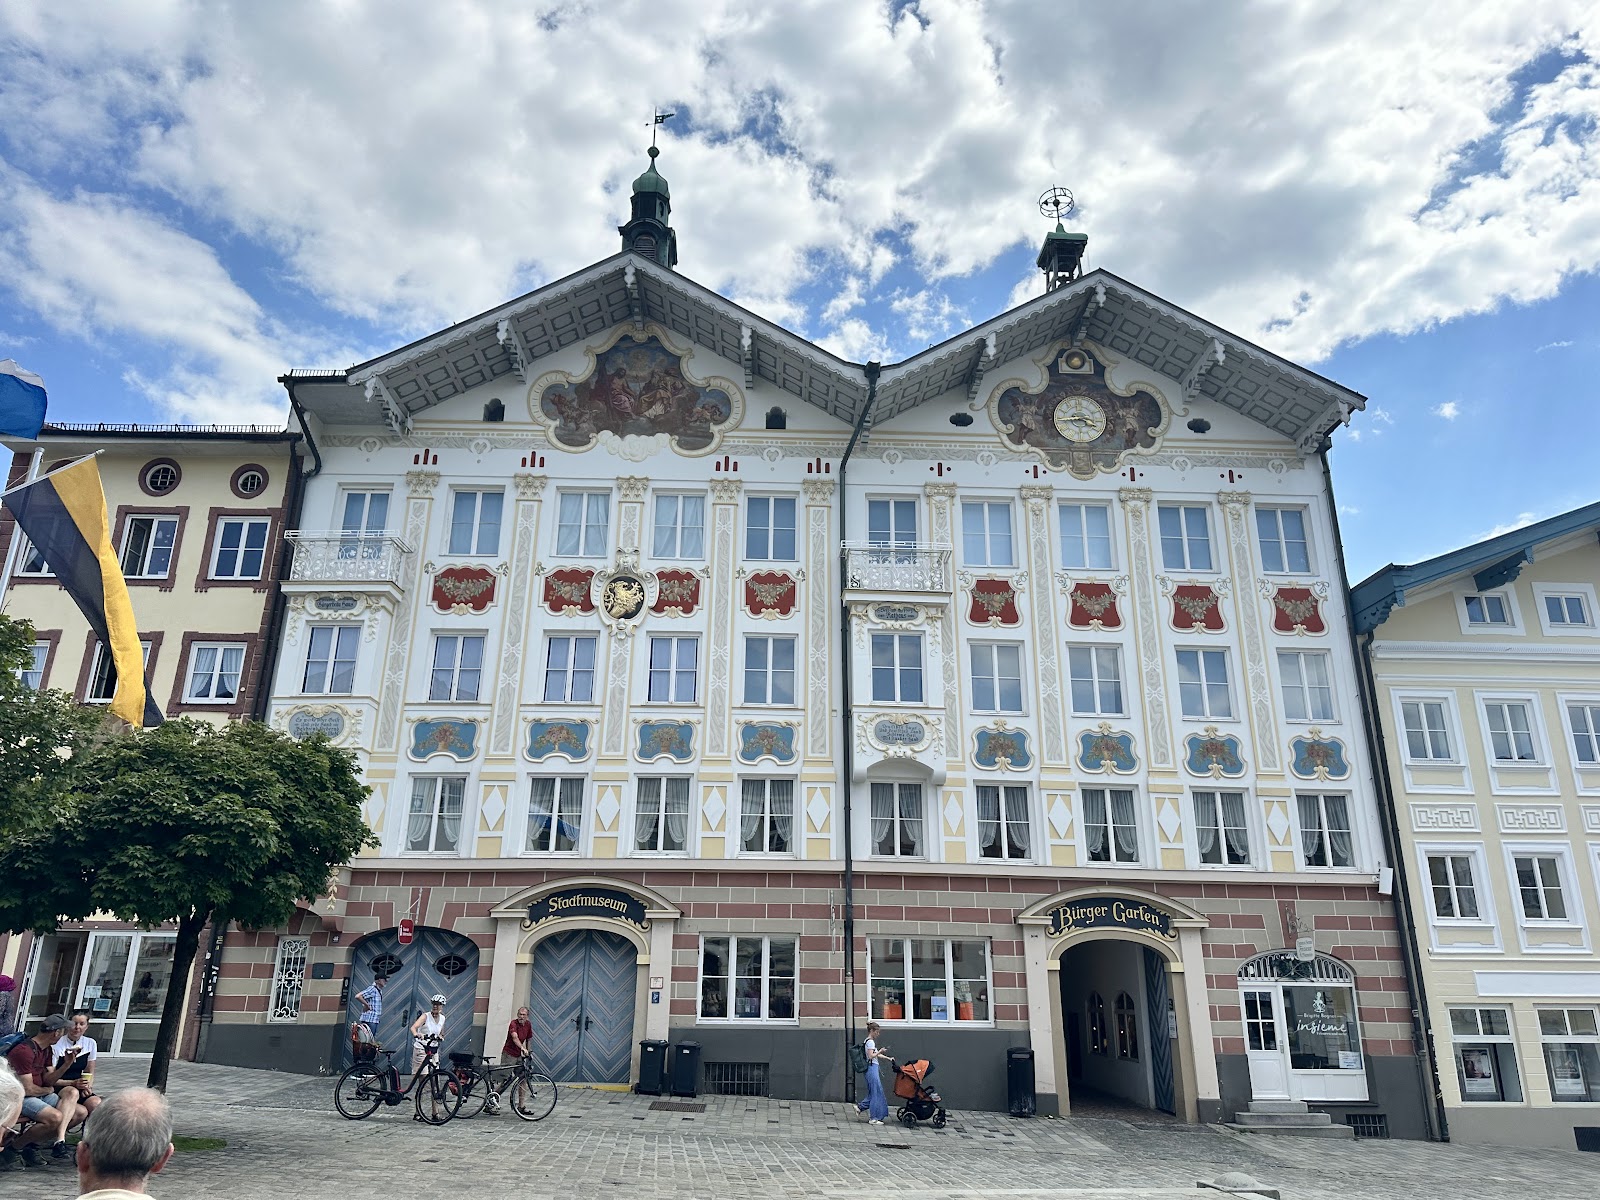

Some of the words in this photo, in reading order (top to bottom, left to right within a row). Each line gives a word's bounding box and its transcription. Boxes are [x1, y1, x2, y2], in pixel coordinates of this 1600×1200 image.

[548, 893, 628, 913] Stadtmuseum
[1059, 905, 1108, 931] Bürger
[1297, 1019, 1347, 1034] insieme
